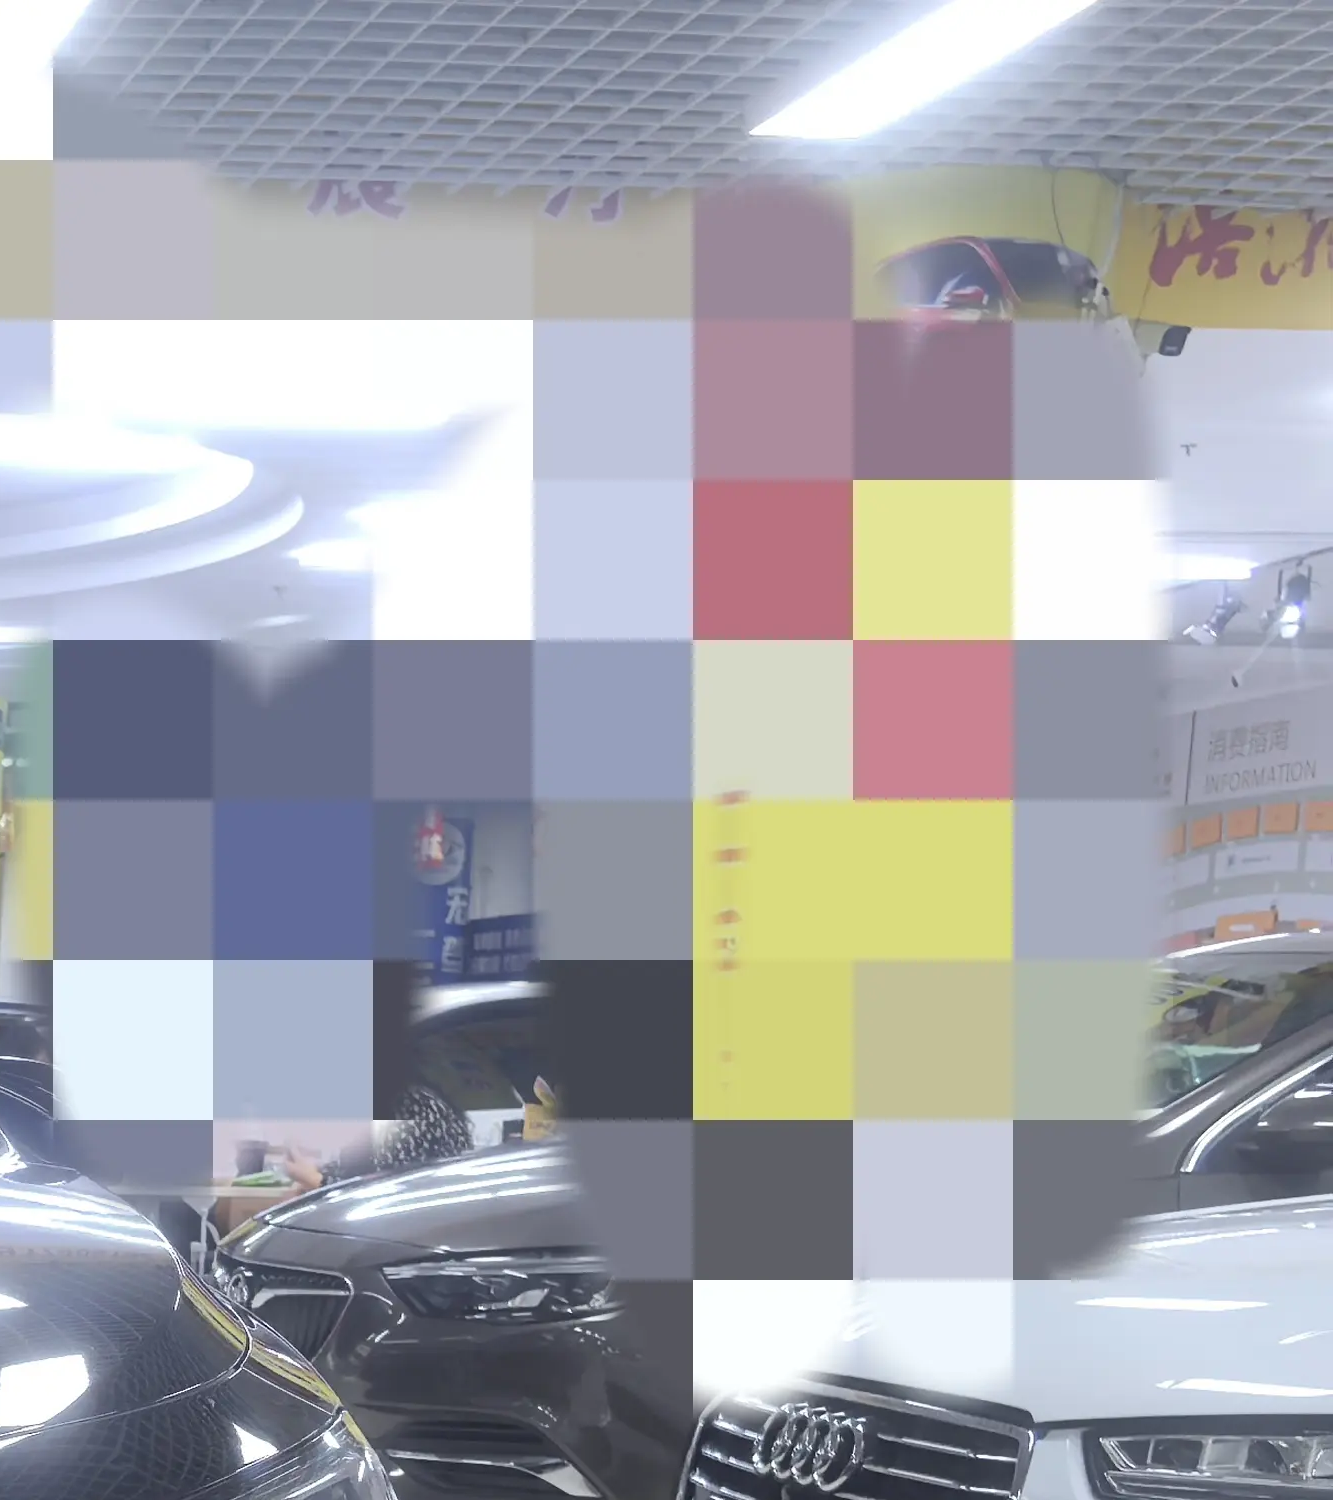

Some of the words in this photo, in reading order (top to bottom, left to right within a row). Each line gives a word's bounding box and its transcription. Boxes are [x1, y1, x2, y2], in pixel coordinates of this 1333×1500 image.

[1208, 721, 1290, 764] 消费指南
[1205, 759, 1317, 795] INFORMATION
